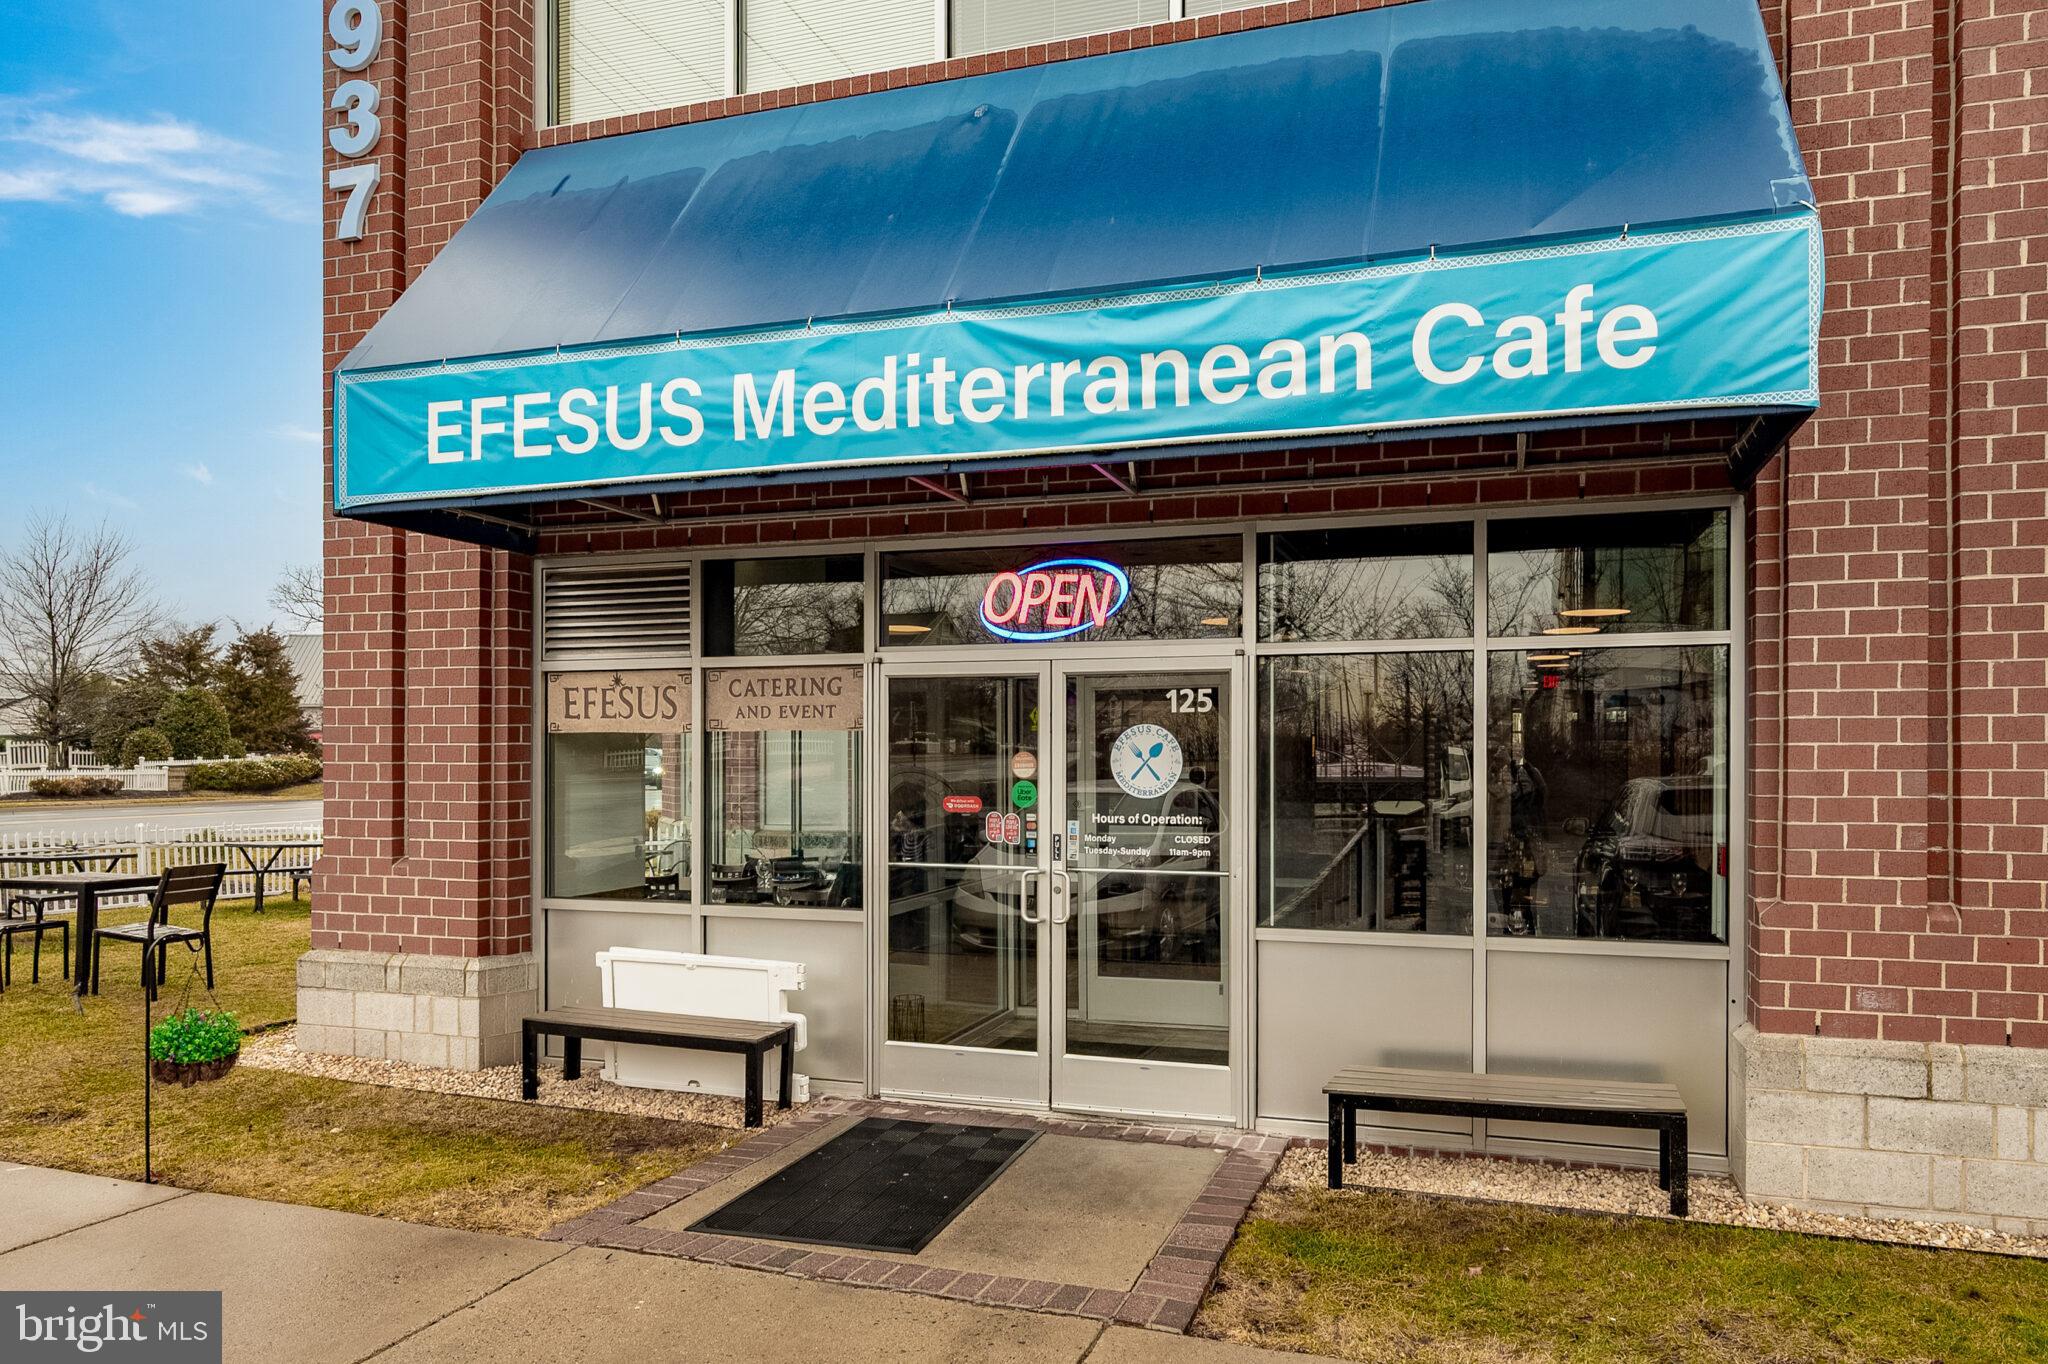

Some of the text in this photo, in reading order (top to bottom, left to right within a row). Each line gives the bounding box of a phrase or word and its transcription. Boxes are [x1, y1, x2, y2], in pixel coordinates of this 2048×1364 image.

[426, 283, 1659, 465] EFESUS Mediterranean Cafe
[984, 571, 1114, 627] OPEN
[728, 676, 843, 698] CATERING
[563, 685, 678, 721] EFESUS
[736, 704, 837, 719] AND EVENT
[1166, 688, 1213, 713] 125
[1114, 726, 1179, 752] EFESUS CAFE
[1115, 771, 1177, 797] MEDITERRANEAN
[1092, 813, 1203, 826] Hours of Operation:
[1084, 834, 1211, 844] Monday CLOSED
[1084, 847, 1211, 858] Tuesday-Sunday 11am-9pm
